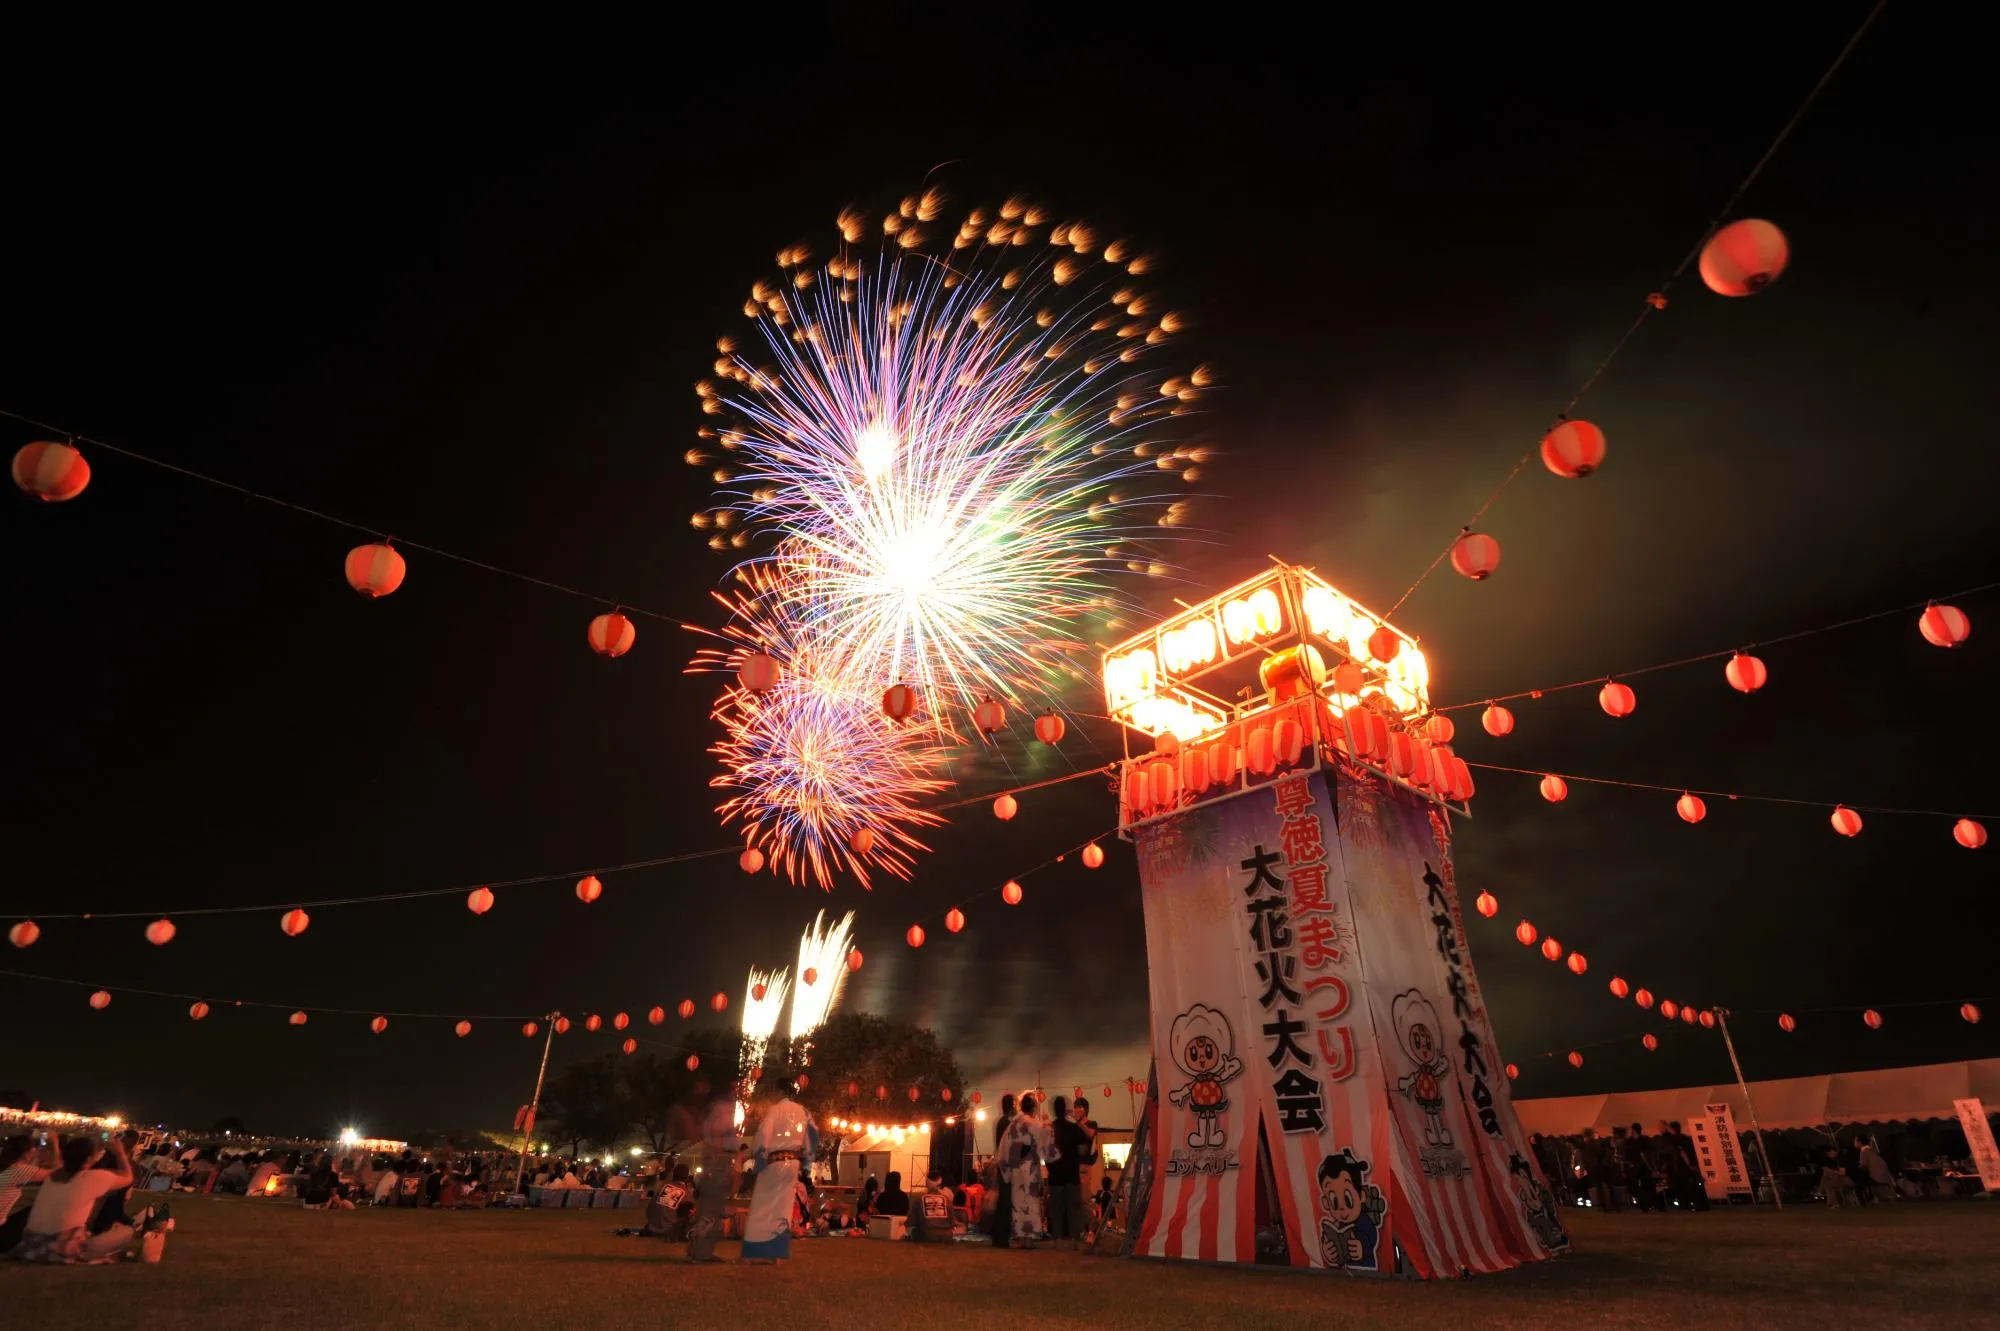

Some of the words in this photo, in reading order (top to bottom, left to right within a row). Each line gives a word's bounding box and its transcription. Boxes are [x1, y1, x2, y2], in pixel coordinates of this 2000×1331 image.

[1242, 846, 1323, 1131] 大花火大会
[1275, 772, 1353, 1079] 尊徳夏まつり
